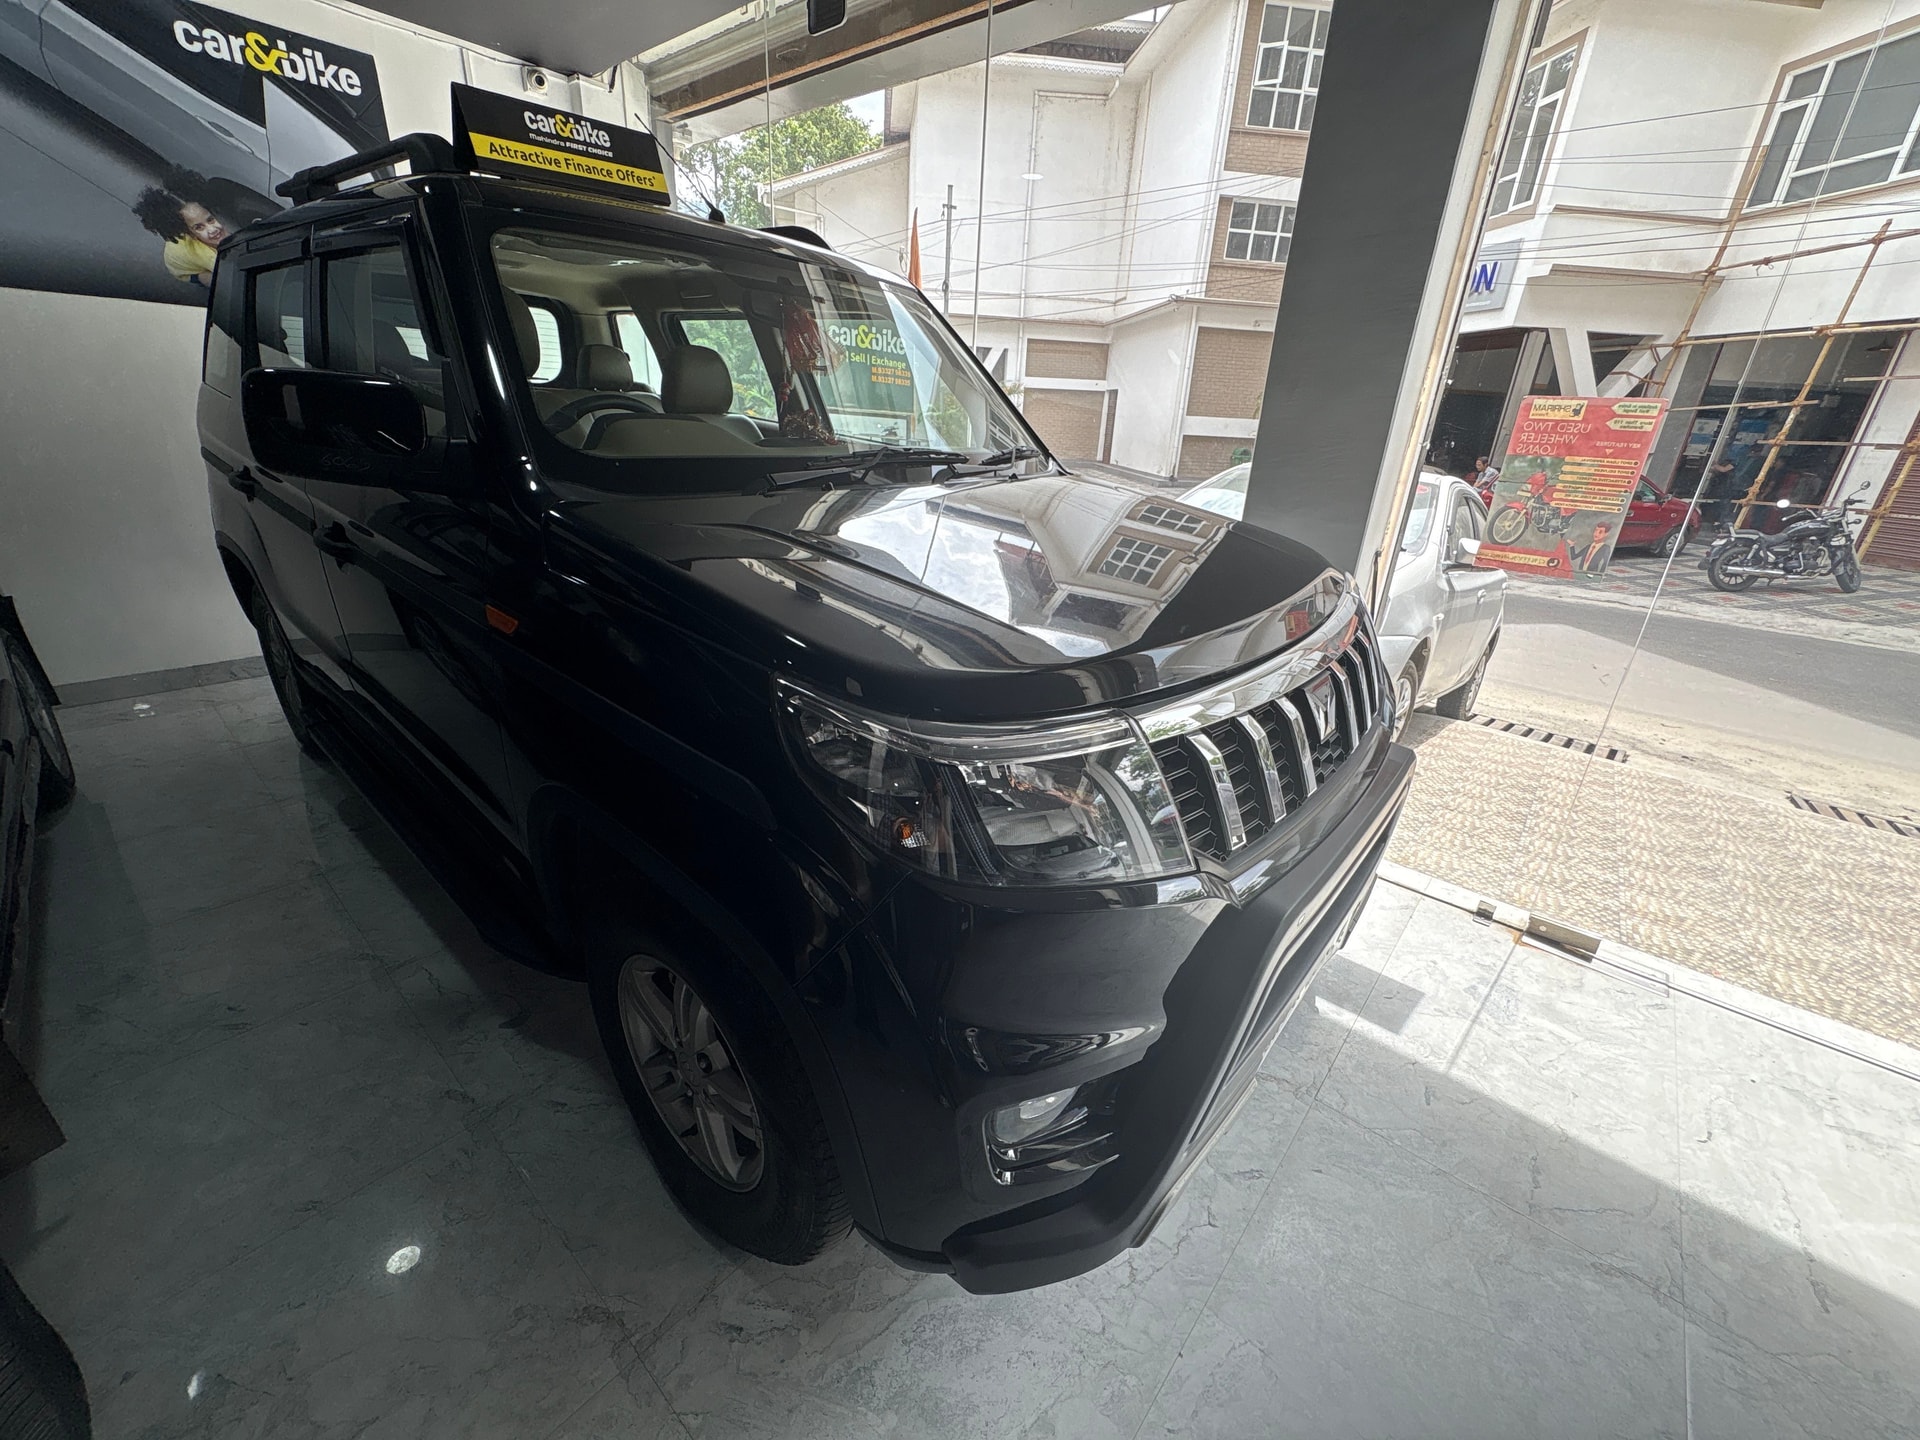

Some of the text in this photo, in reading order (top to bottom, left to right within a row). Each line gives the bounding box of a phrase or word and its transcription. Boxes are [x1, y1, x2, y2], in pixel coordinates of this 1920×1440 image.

[173, 20, 362, 97] car&bike
[523, 110, 611, 148] car&bike
[489, 141, 561, 169] Attractive
[564, 157, 614, 179] Finance
[566, 141, 588, 152] FIRST
[587, 146, 613, 158] CHOICE
[850, 352, 866, 363] Sell
[871, 356, 907, 369] Exchange
